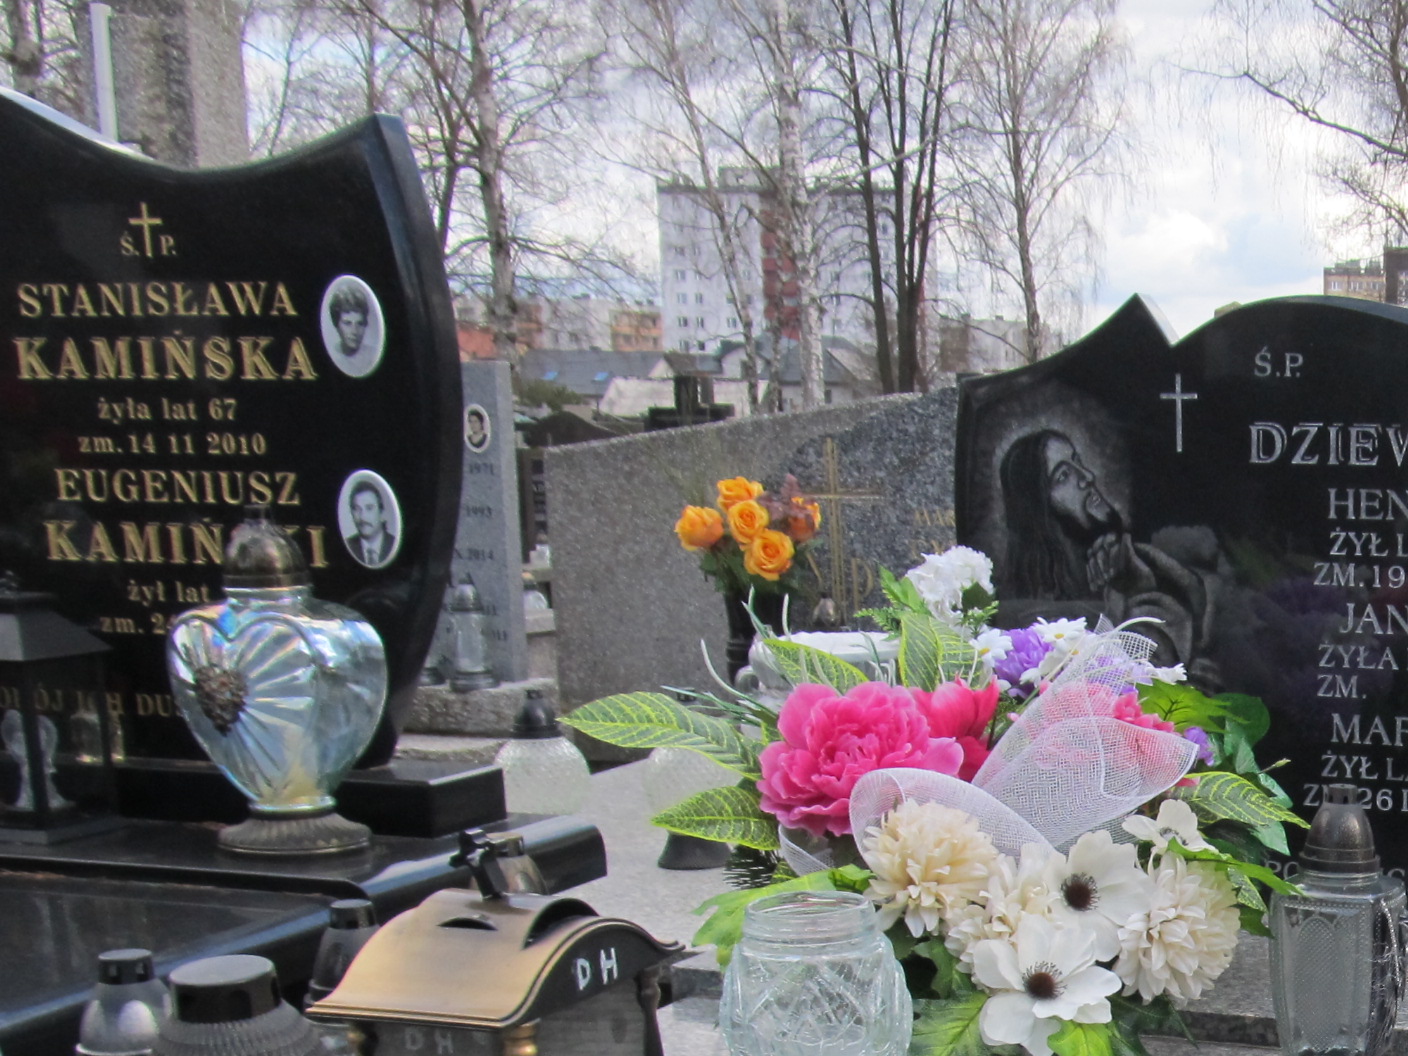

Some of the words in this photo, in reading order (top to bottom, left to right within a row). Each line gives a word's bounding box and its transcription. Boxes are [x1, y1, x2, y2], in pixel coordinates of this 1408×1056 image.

[17, 281, 299, 317] STANISŁAWA
[13, 331, 319, 381] KAMIŃSKA
[161, 397, 198, 421] lat
[208, 397, 237, 421] 67
[79, 436, 123, 454] zm.
[128, 432, 156, 454] 14
[168, 432, 195, 454] 11
[206, 432, 267, 455] 2010
[54, 468, 300, 505] EUGENIUSZ
[43, 517, 329, 569] KAMIŃI
[1330, 527, 1388, 556] ŻYŁ
[175, 580, 210, 602] lat
[1318, 640, 1399, 670] ŻYŁA
[1317, 674, 1367, 699] ZM.
[1321, 750, 1379, 780] ŻYŁ
[1357, 788, 1393, 811] 26
